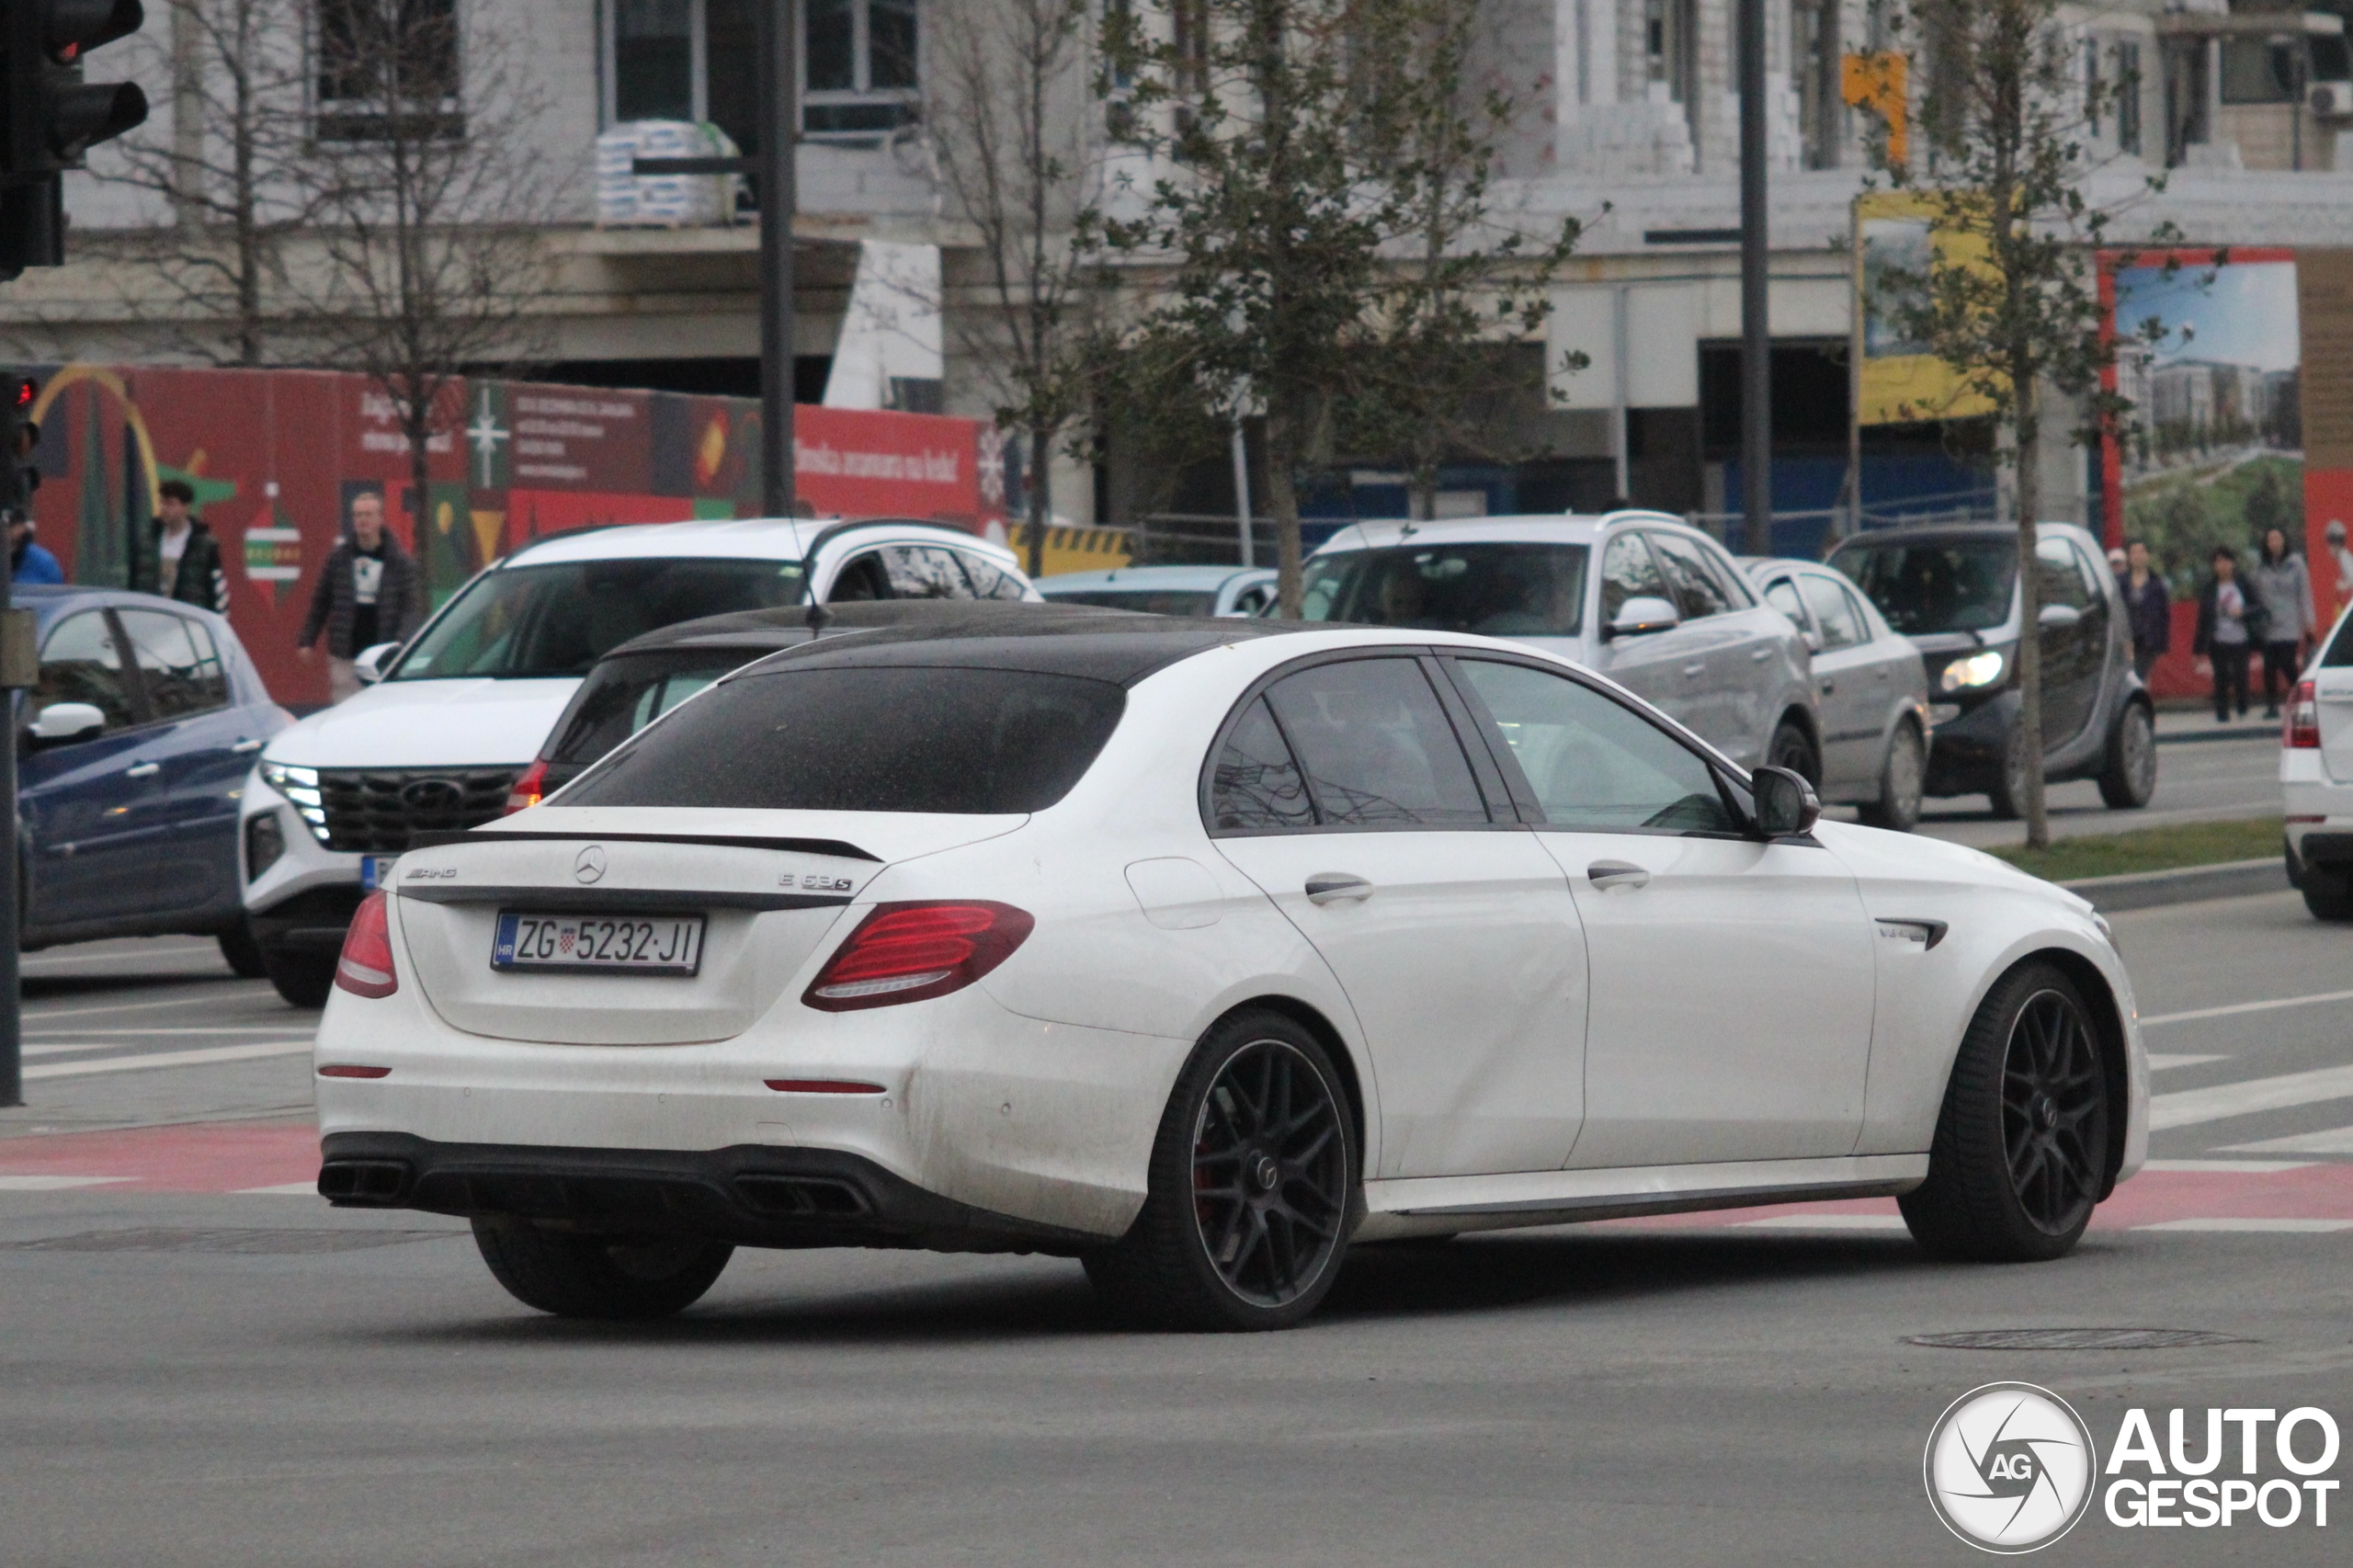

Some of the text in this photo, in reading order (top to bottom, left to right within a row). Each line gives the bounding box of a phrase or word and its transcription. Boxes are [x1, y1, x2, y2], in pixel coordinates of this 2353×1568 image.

[779, 873, 795, 886] E
[517, 919, 557, 960] ZG
[497, 945, 513, 956] HR
